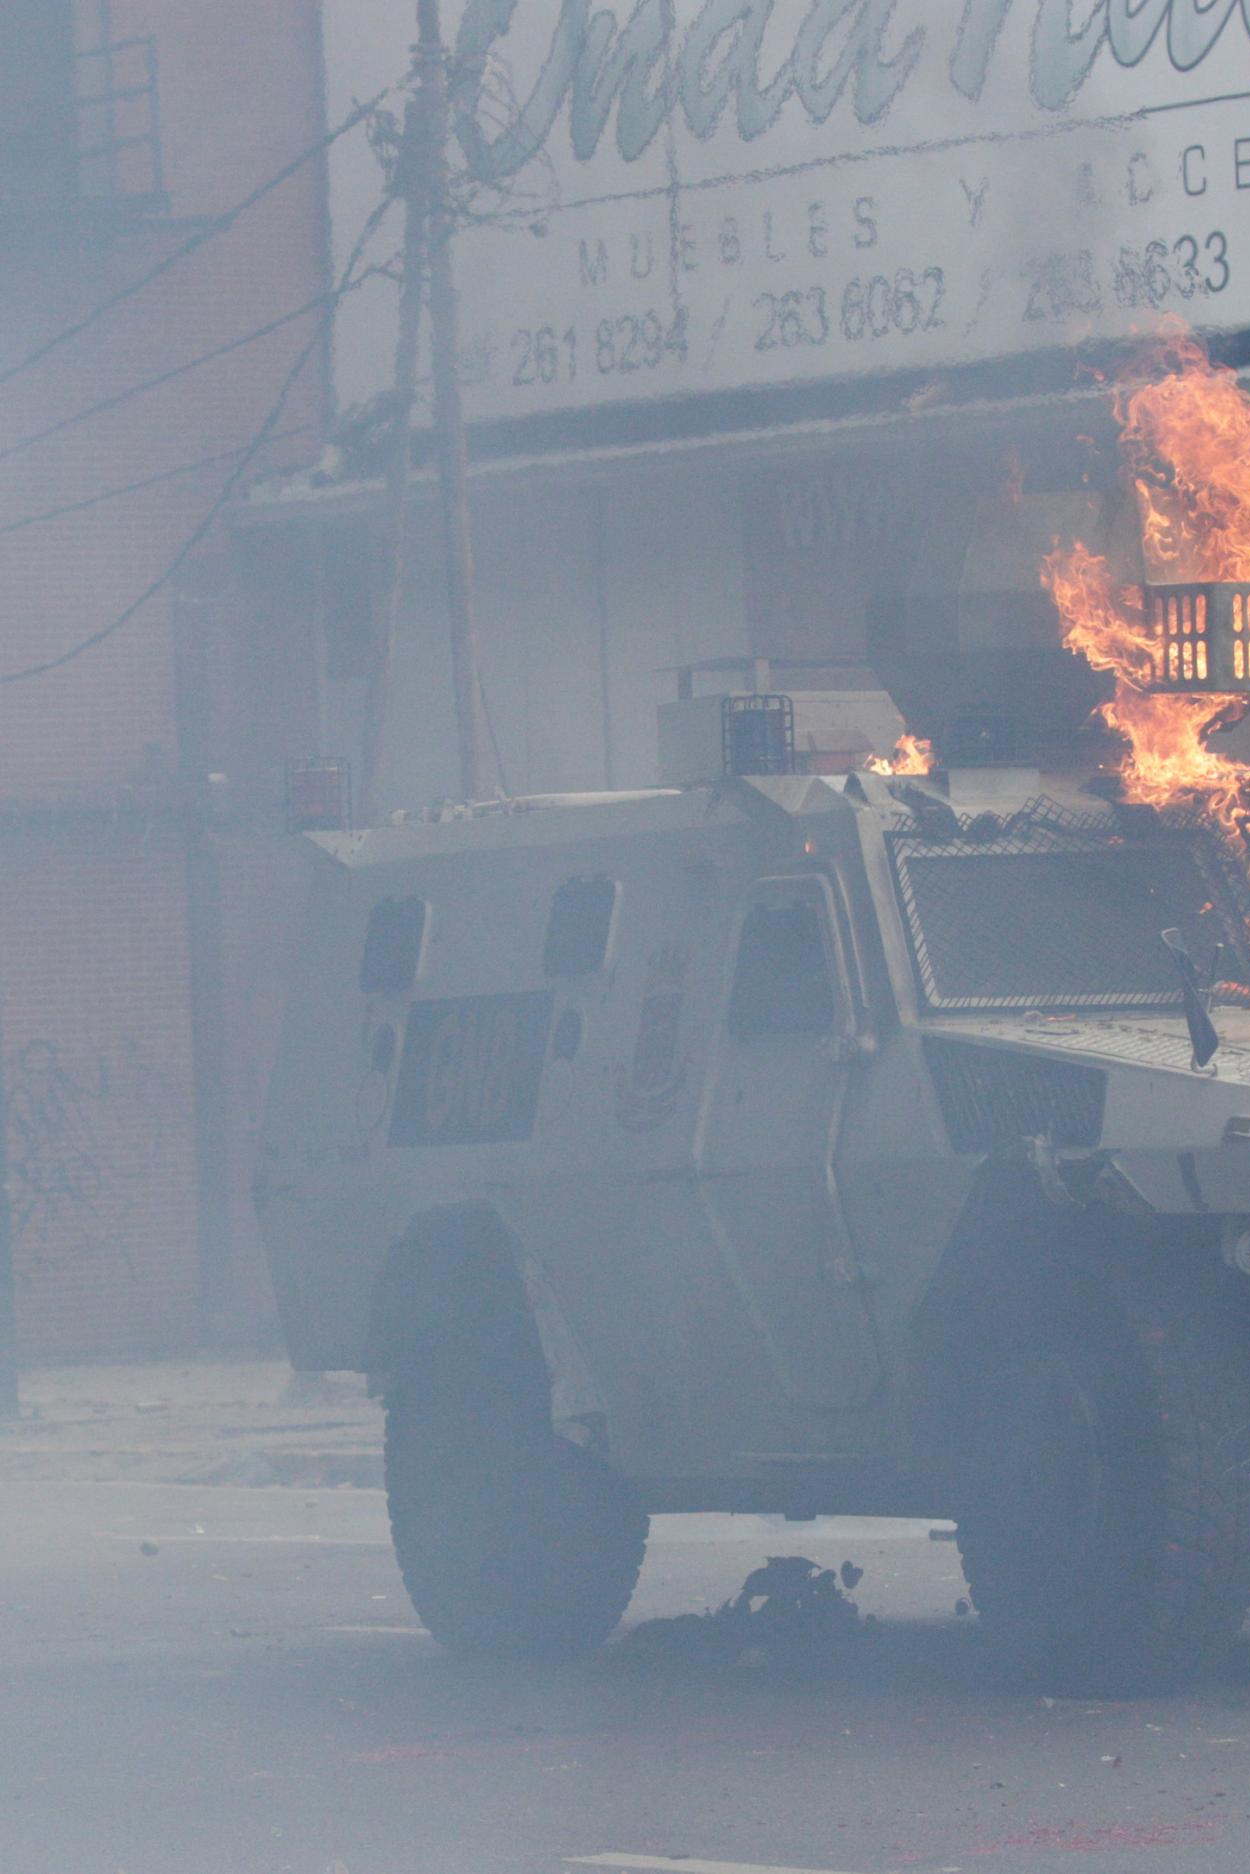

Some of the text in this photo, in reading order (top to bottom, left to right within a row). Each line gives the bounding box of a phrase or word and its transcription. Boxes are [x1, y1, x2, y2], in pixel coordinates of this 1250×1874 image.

[579, 196, 877, 287] MUEBLES
[959, 176, 990, 226] Y
[511, 326, 576, 387] 261
[596, 306, 690, 375] 8294
[753, 288, 829, 351] 263
[842, 266, 945, 341] 6062
